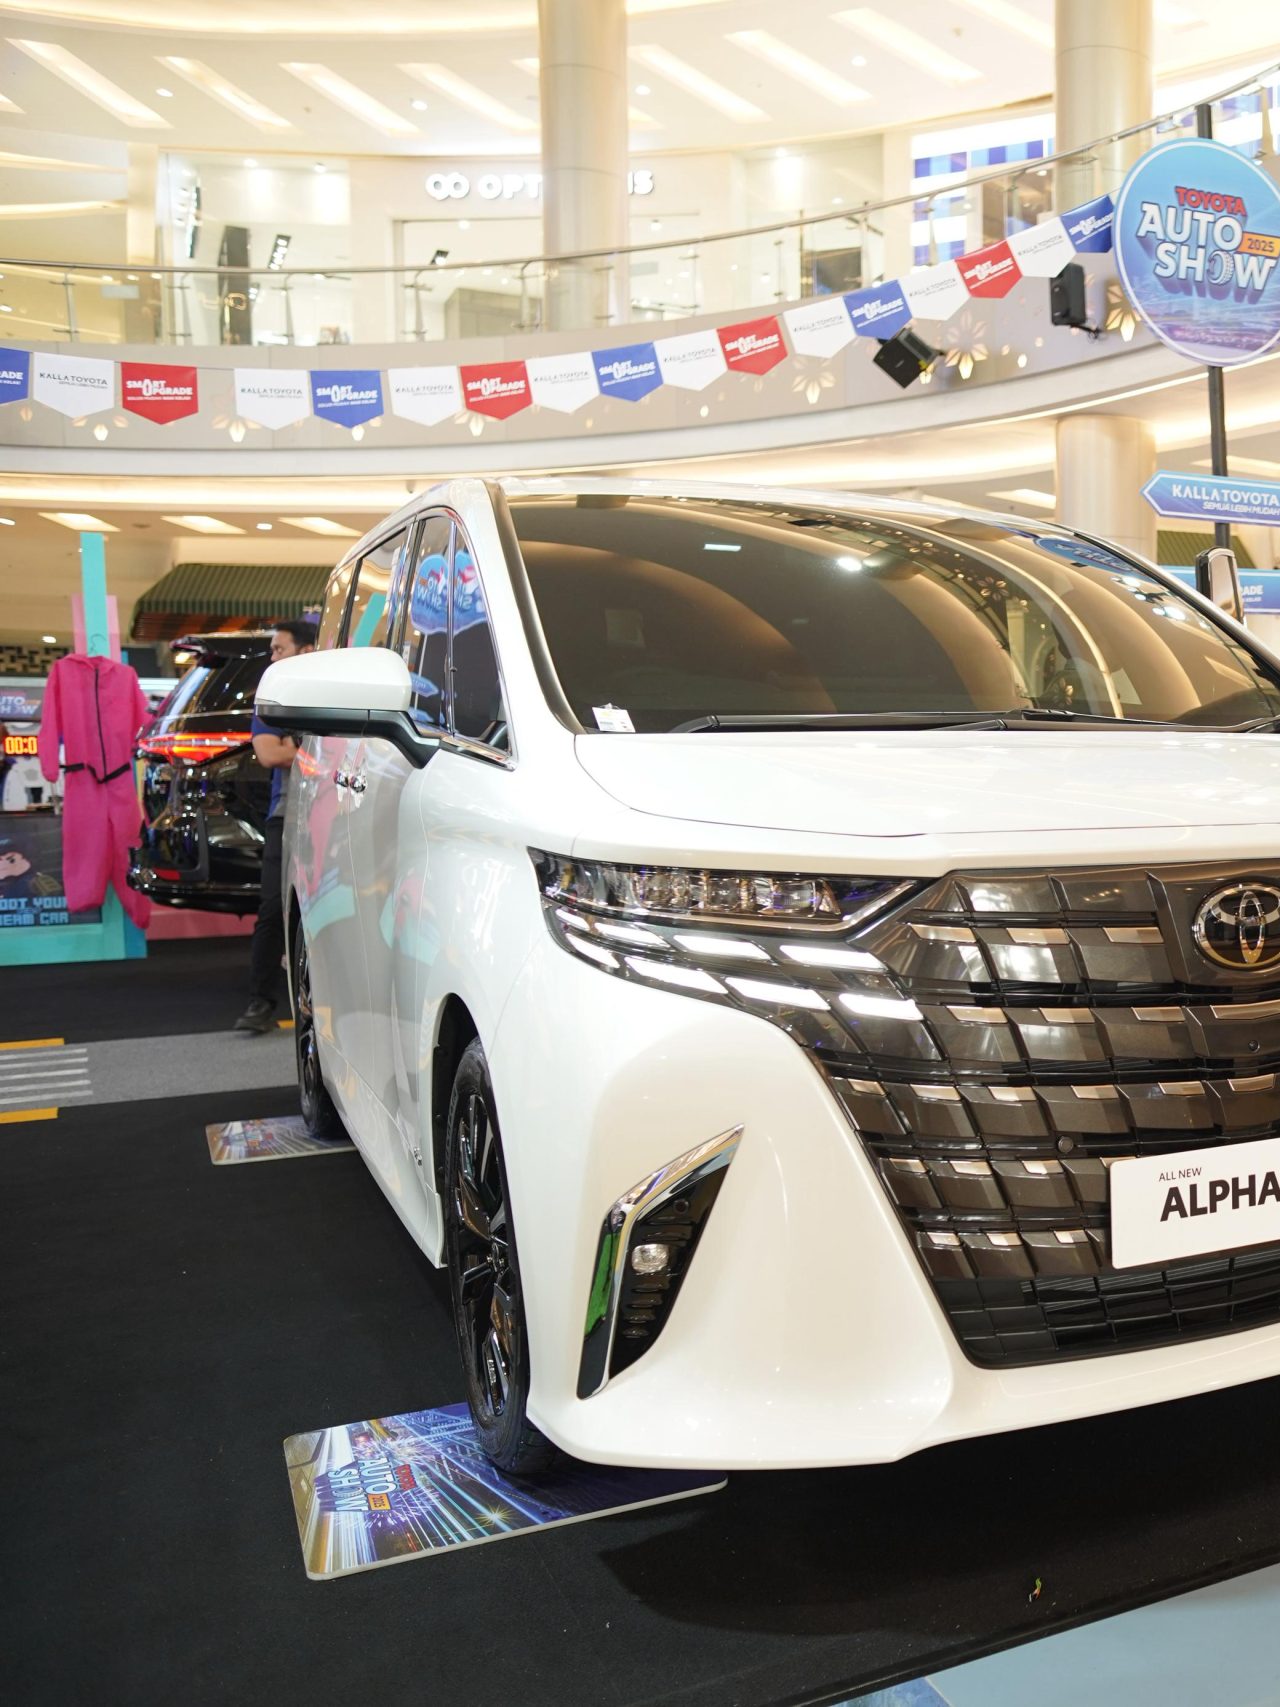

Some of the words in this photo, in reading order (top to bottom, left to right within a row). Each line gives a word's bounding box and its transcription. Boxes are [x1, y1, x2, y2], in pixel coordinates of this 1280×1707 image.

[478, 174, 542, 200] OPT
[628, 170, 654, 195] IS
[1174, 186, 1246, 216] TOYOTA
[1136, 202, 1243, 250] AUTO
[1248, 238, 1275, 252] 2025
[1154, 242, 1276, 290] SHOW
[0, 370, 23, 379] ADE
[1172, 484, 1220, 501] KALLA
[1222, 490, 1280, 506] TOYOTA
[1240, 585, 1264, 596] ADE
[5, 736, 38, 754] 00:0
[1158, 1169, 1177, 1182] ALL
[1178, 1167, 1202, 1179] NEW
[328, 1469, 369, 1511] SHOW
[358, 1457, 397, 1494] AUTO
